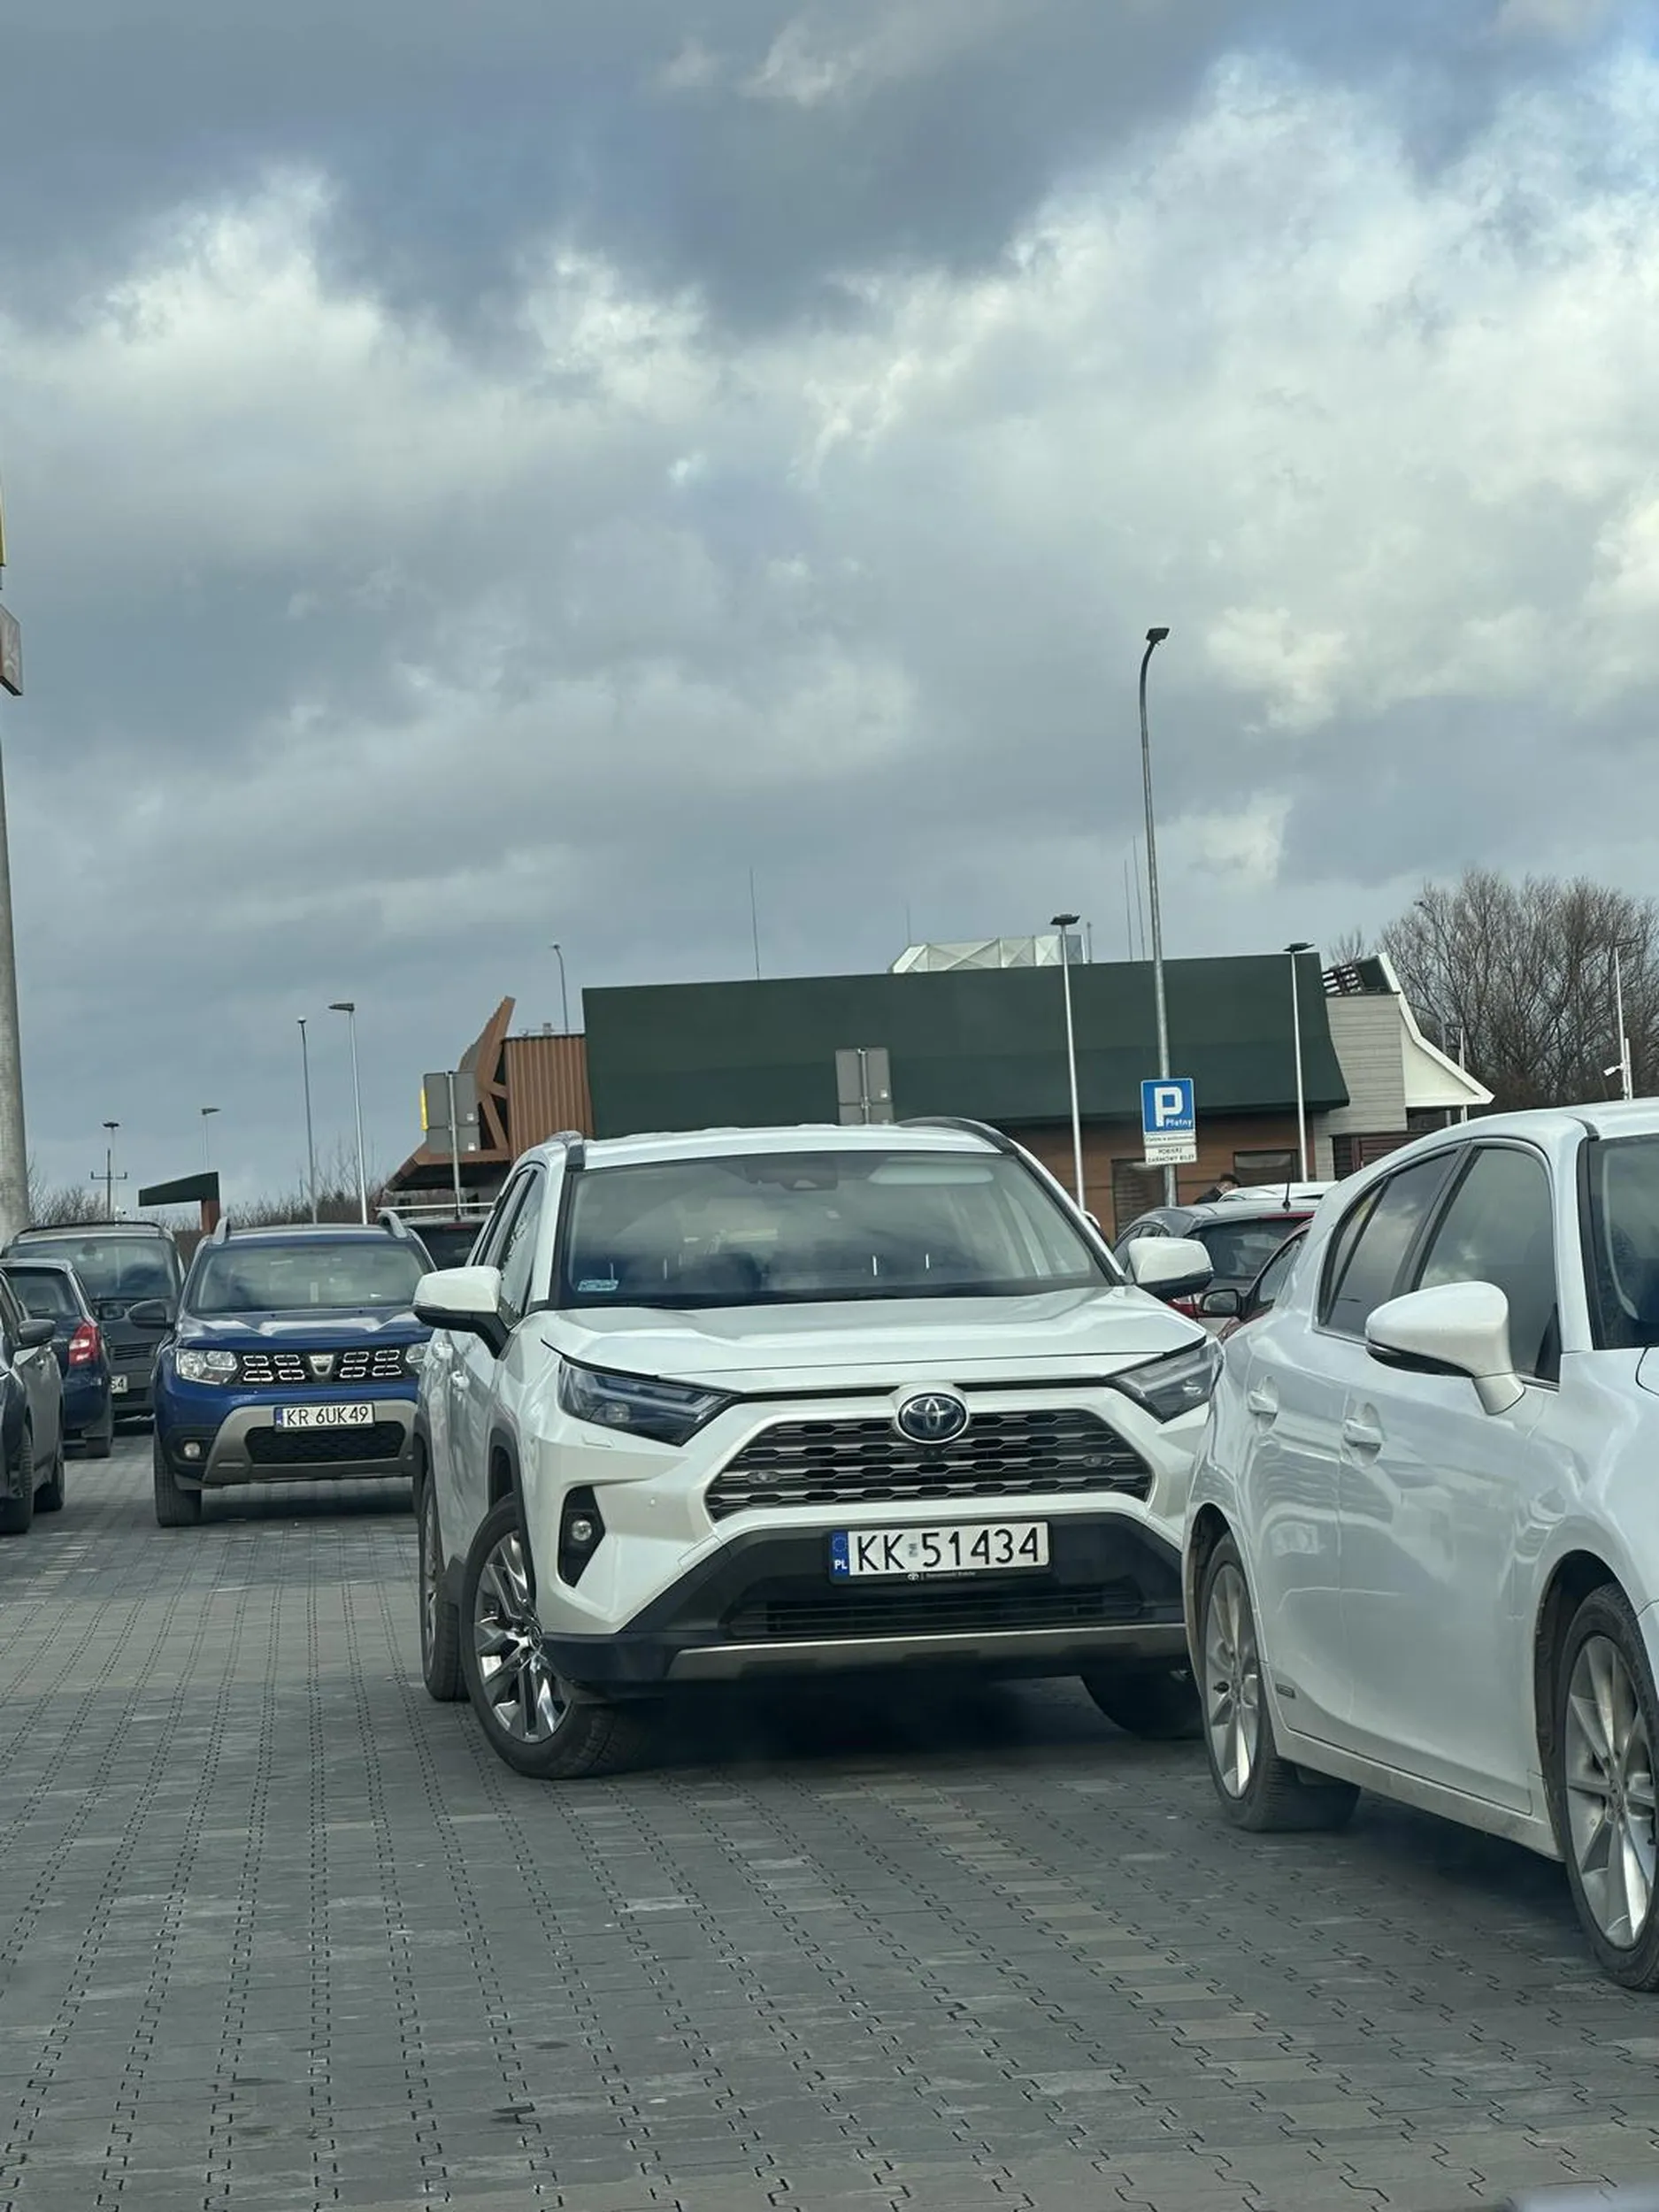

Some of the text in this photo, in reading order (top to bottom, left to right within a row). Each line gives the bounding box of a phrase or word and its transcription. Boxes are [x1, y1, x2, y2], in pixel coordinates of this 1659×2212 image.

[1155, 1087, 1183, 1126] P
[287, 1406, 368, 1425] KR 6UK49
[857, 1527, 1039, 1571] KK 51434
[834, 1560, 848, 1570] PL
